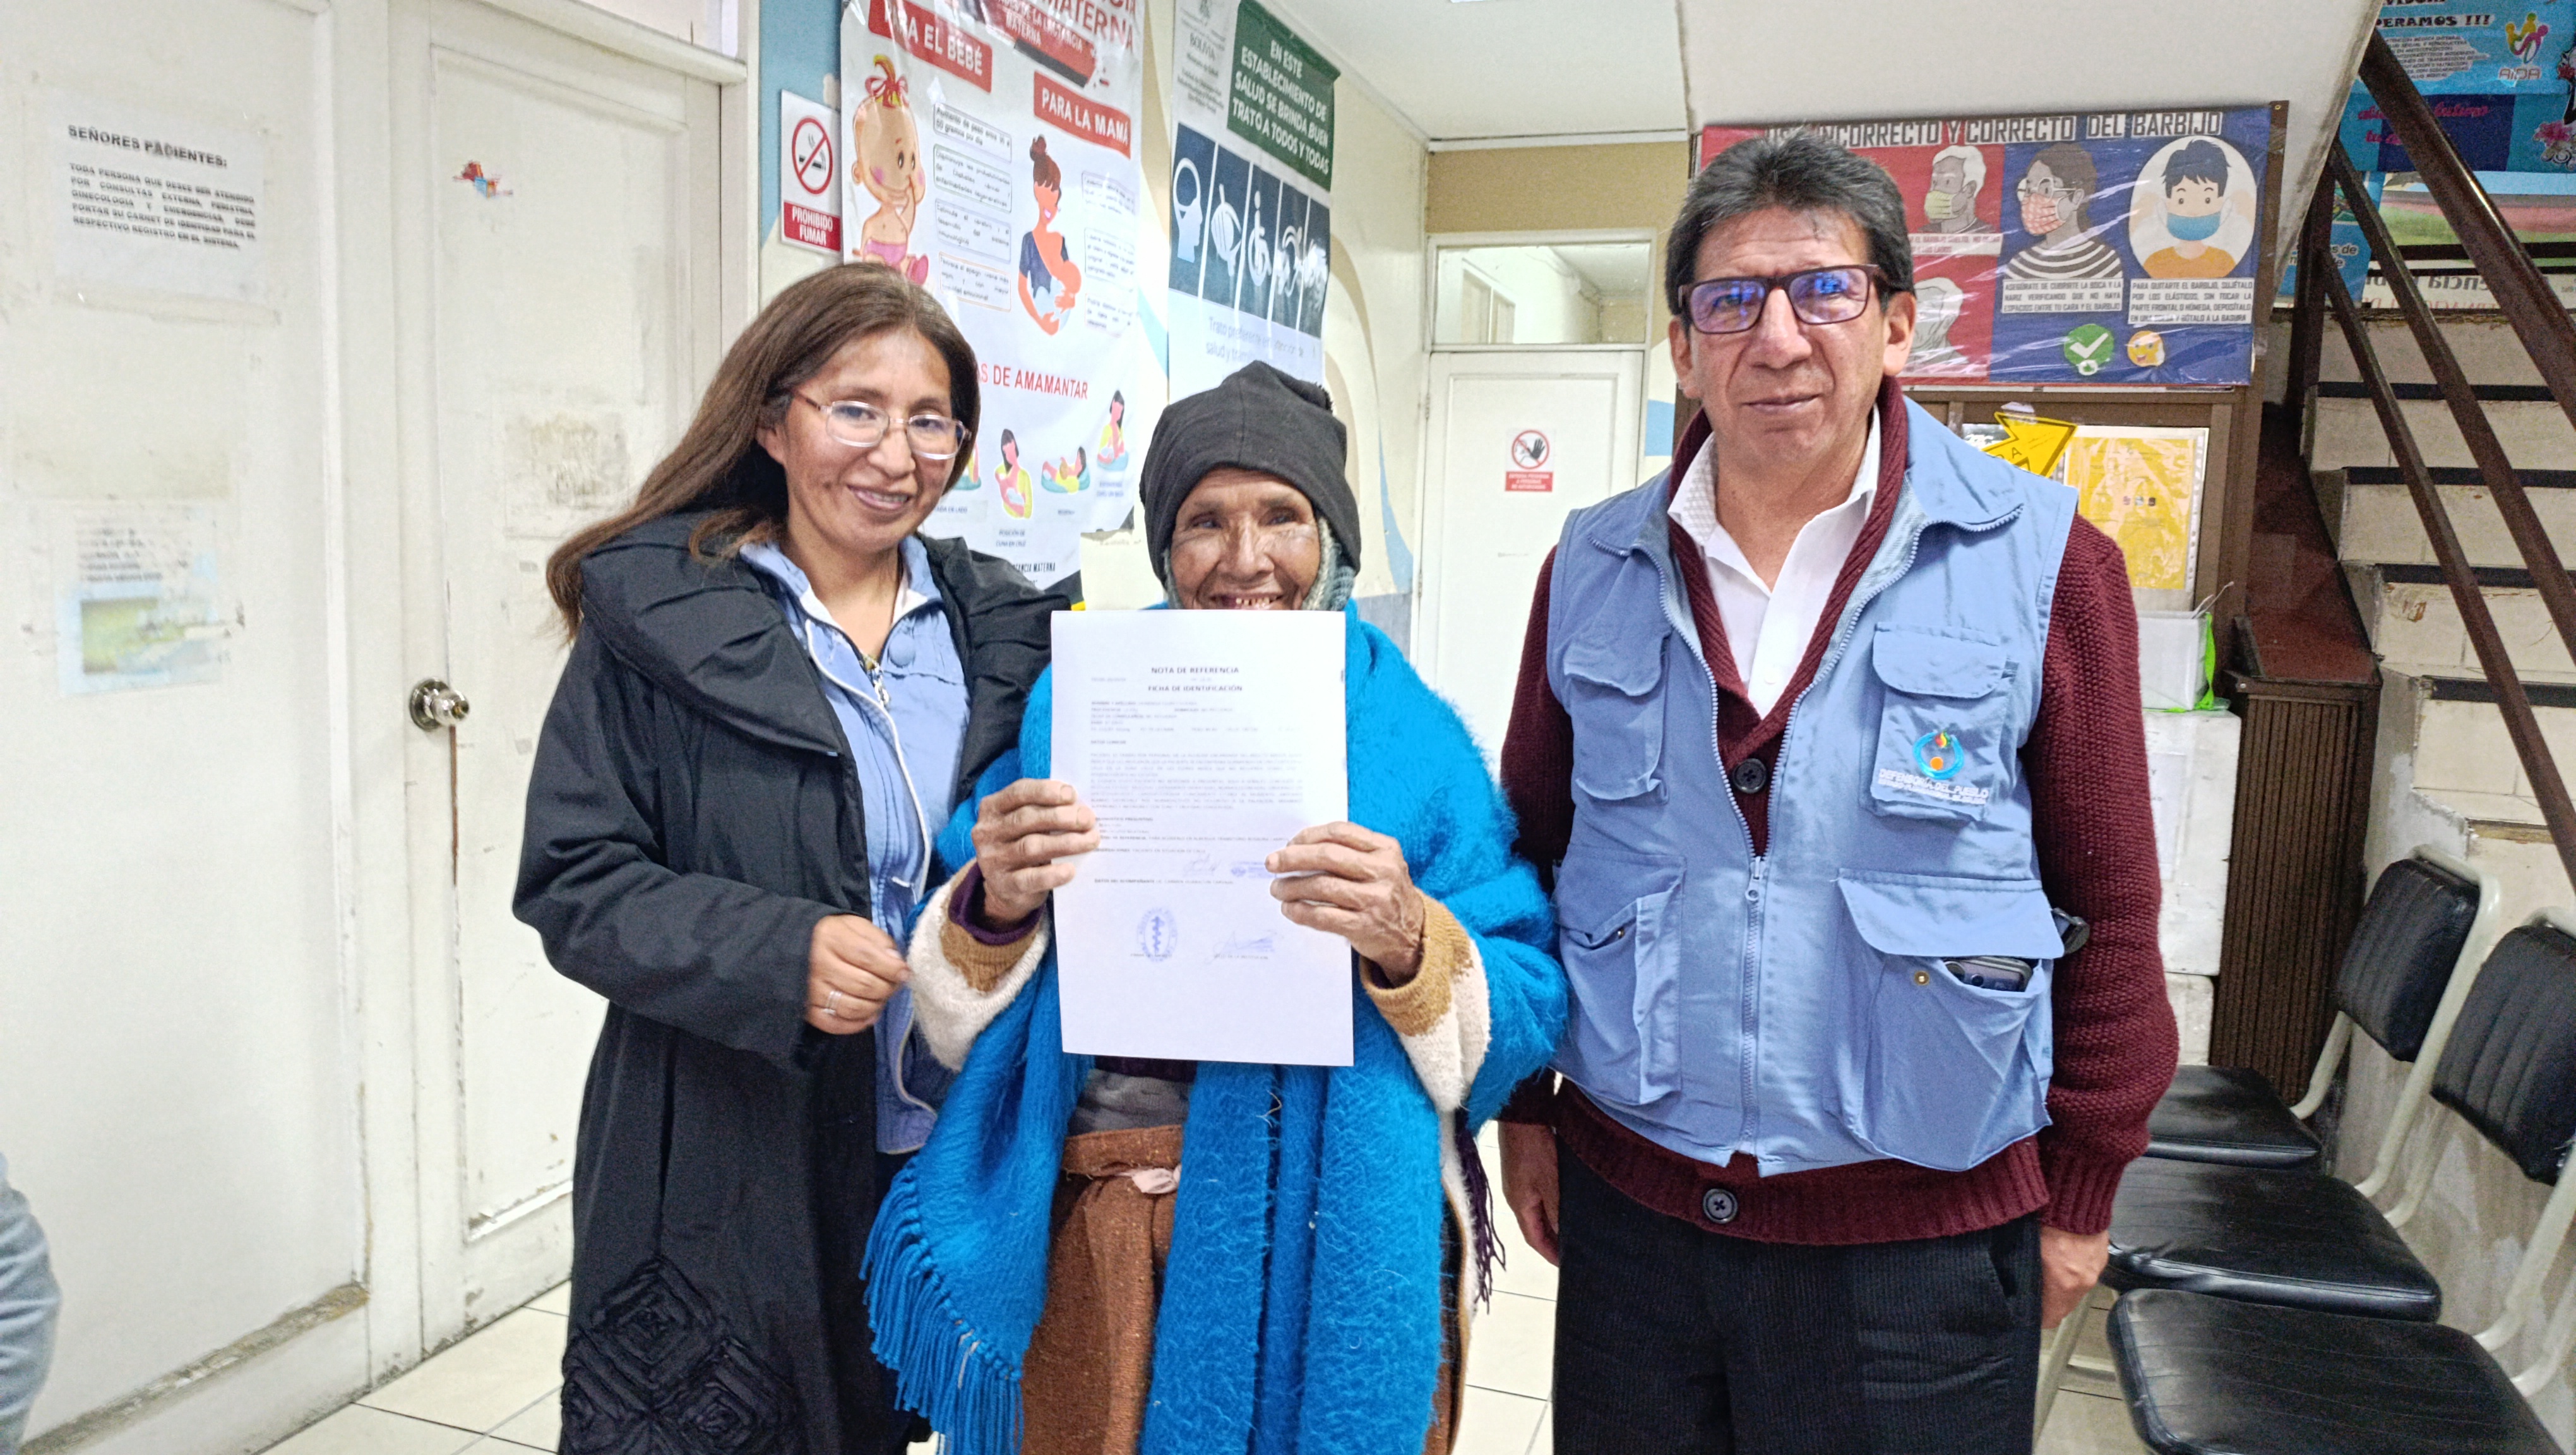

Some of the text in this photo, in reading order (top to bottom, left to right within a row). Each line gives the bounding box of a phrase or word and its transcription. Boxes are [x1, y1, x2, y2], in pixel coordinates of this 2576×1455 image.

[1006, 10, 1042, 46] MATERNA
[1033, 8, 1042, 27] LA
[2375, 15, 2457, 27] PERAMOS
[924, 23, 943, 55] EL
[948, 35, 982, 76] BEBÉ
[1270, 39, 1303, 79] EN ESTE
[1241, 45, 1315, 113] ESTABLECIMIENTO
[1315, 100, 1327, 122] DE
[1042, 87, 1128, 146] PARA LA MAMÁ
[1235, 71, 1265, 105] SALUD
[1266, 92, 1277, 114] SE
[1278, 100, 1308, 136] BRINDA
[1308, 121, 1328, 148] BUEN
[68, 125, 227, 168] SEÑORES PACIENTES:
[1232, 96, 1329, 176] TRATO A TODOS Y TODAS
[1813, 112, 2222, 148] NCORRECTO Y CORRECTO DEL BARBIJO
[69, 163, 95, 174] TODA
[98, 168, 140, 183] PERSONA
[145, 176, 162, 186] QUE
[71, 176, 90, 186] POR
[100, 181, 153, 197] CONSULTAS
[72, 203, 109, 215] PORTAR
[112, 209, 124, 217] SU
[127, 211, 161, 223] CARNET
[177, 220, 221, 232] IDENTIDAD
[223, 228, 244, 237] PARA
[146, 202, 152, 211] Y
[792, 206, 833, 232] PROHIBIDO
[73, 215, 129, 231] RESPECTIVO
[132, 225, 175, 238] REGISTRO
[799, 224, 826, 246] FUMAR
[2342, 244, 2357, 254] de
[993, 364, 1011, 387] DE
[1014, 369, 1088, 400] AMAMANTAR
[1183, 684, 1243, 692] IDENTIFICACIÓN
